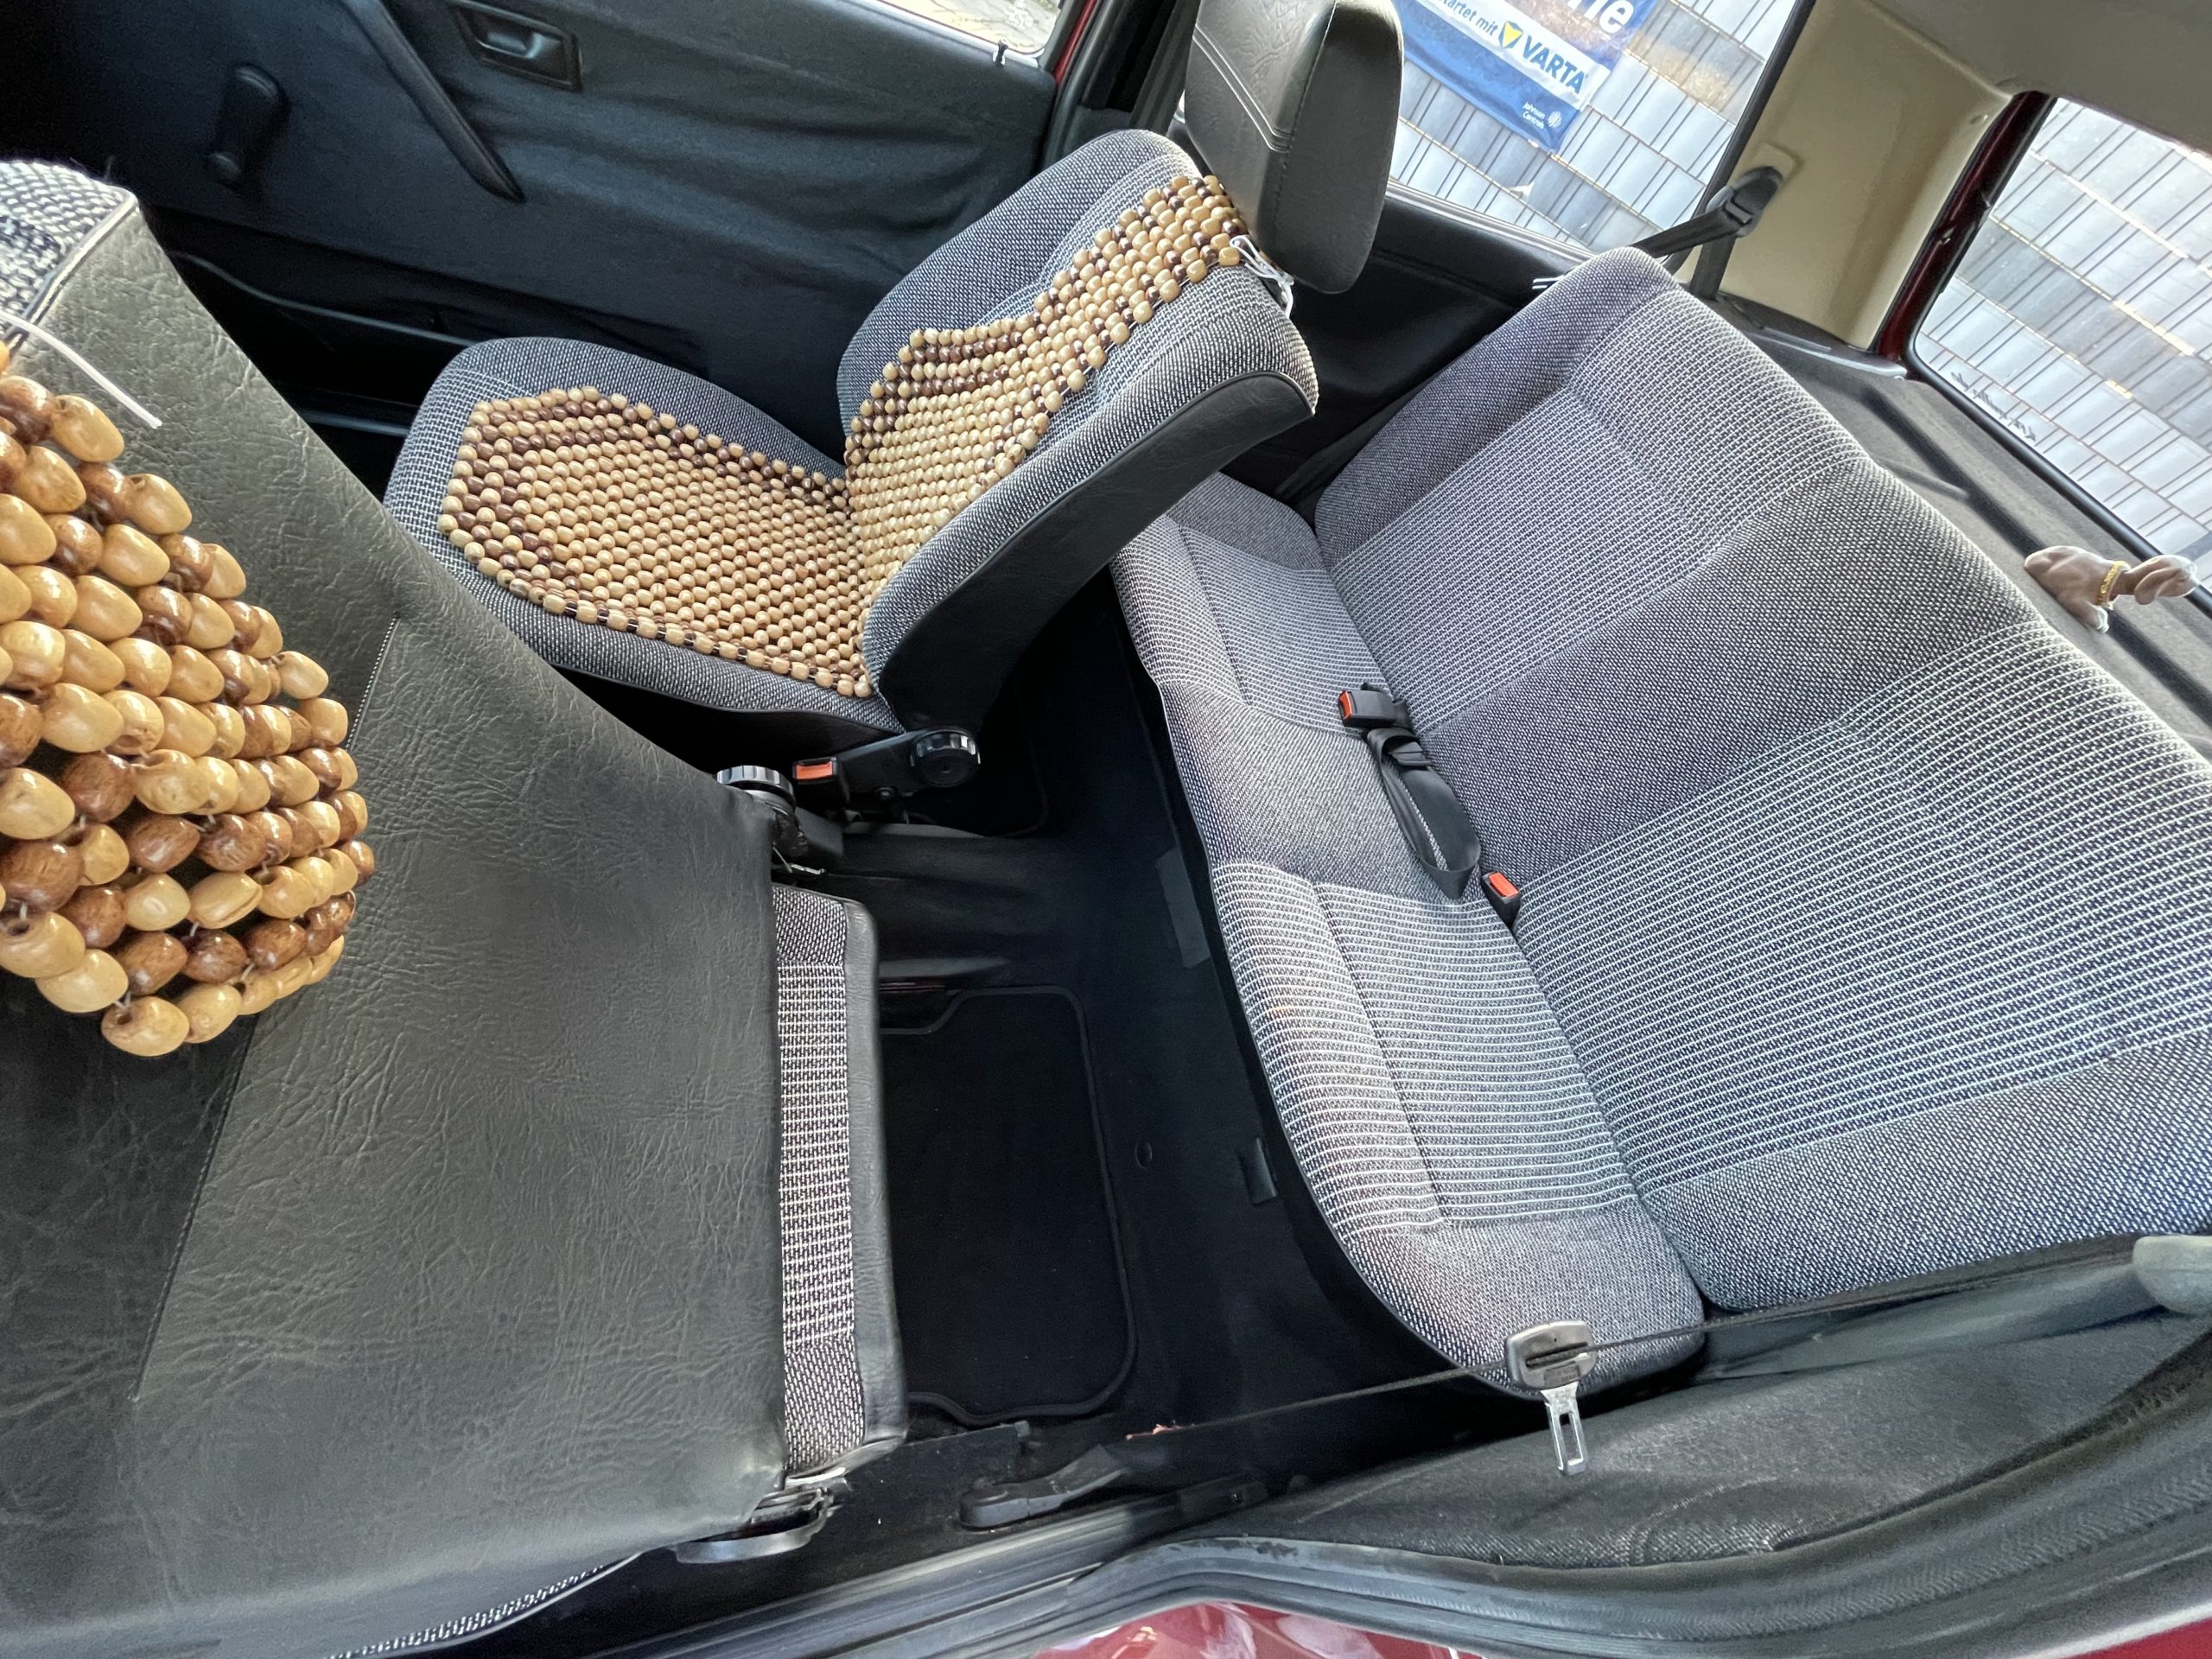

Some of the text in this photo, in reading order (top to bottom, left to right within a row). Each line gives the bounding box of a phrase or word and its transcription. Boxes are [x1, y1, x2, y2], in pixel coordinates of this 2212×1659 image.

[1475, 17, 1498, 36] mit
[1522, 35, 1585, 94] VARTA
[1522, 101, 1546, 120] Johnson
